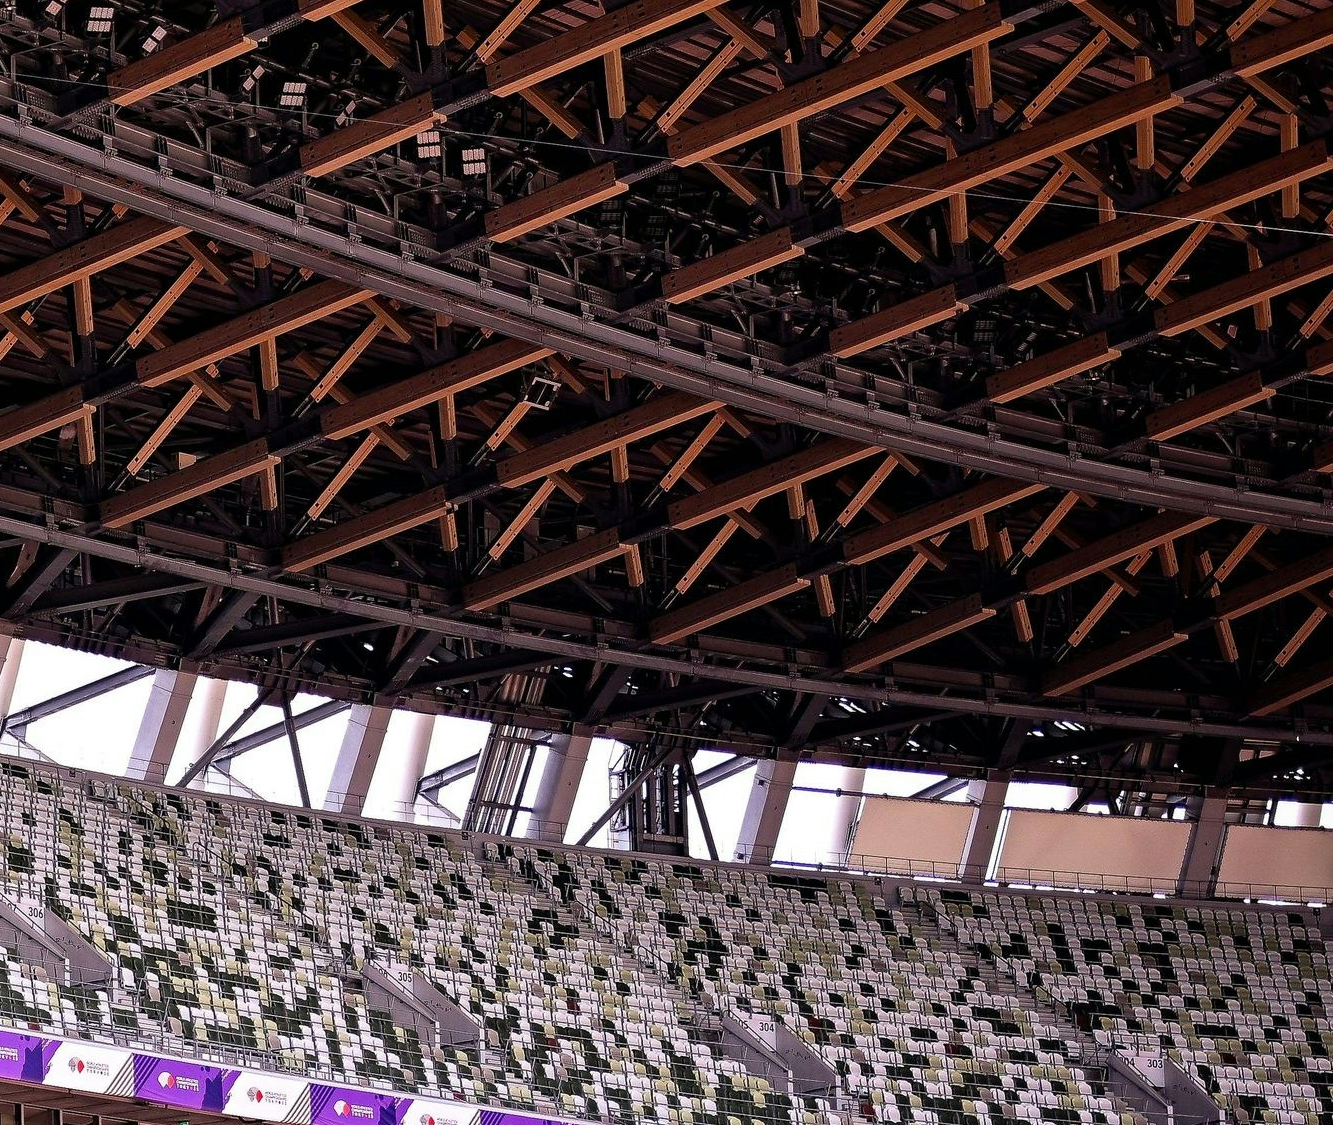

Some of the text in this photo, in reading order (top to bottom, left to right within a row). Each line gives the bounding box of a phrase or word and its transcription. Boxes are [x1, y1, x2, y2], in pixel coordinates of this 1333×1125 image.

[28, 906, 44, 919] 306
[397, 971, 413, 983] 305
[759, 1022, 774, 1032] 304
[1147, 1059, 1163, 1069] 303
